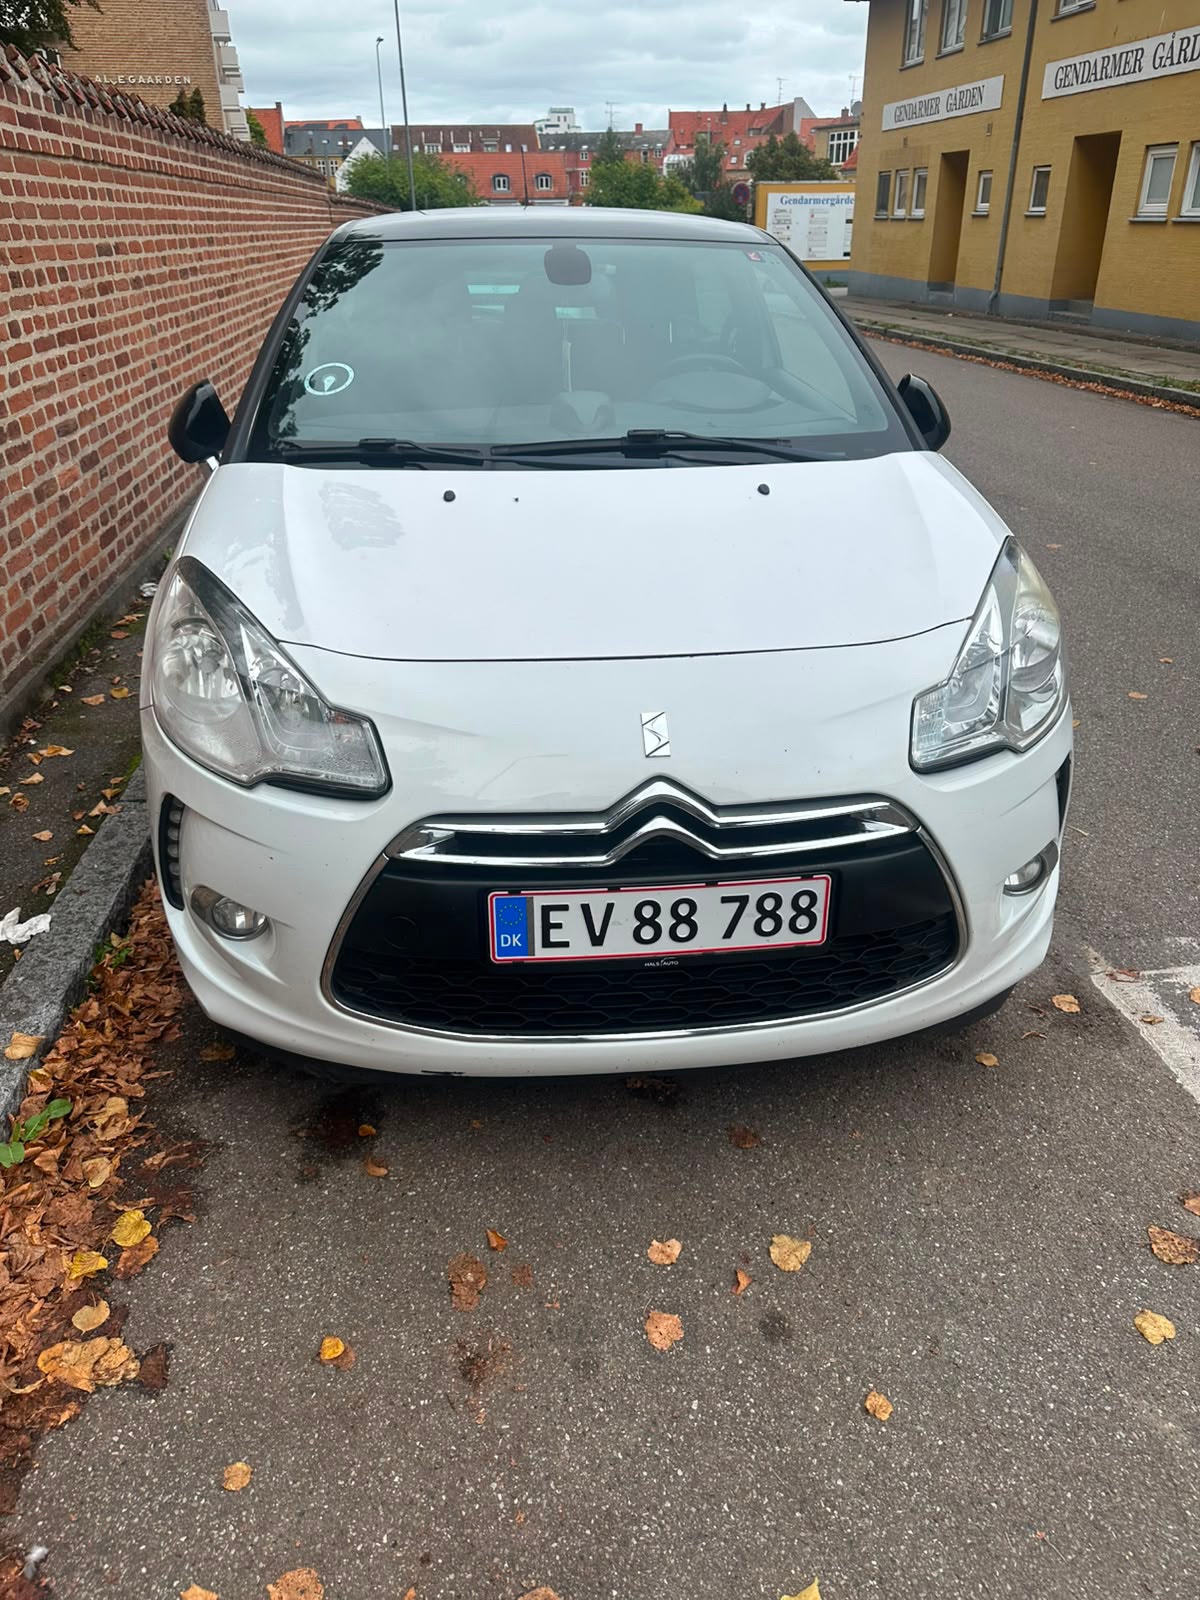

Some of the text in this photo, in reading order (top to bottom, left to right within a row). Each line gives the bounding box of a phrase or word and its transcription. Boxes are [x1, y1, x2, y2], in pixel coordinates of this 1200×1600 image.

[1054, 46, 1145, 90] GENDARMER
[893, 87, 985, 123] GENDARMER GÅRDEN
[540, 889, 819, 949] EV 88 788
[500, 933, 523, 948] DK
